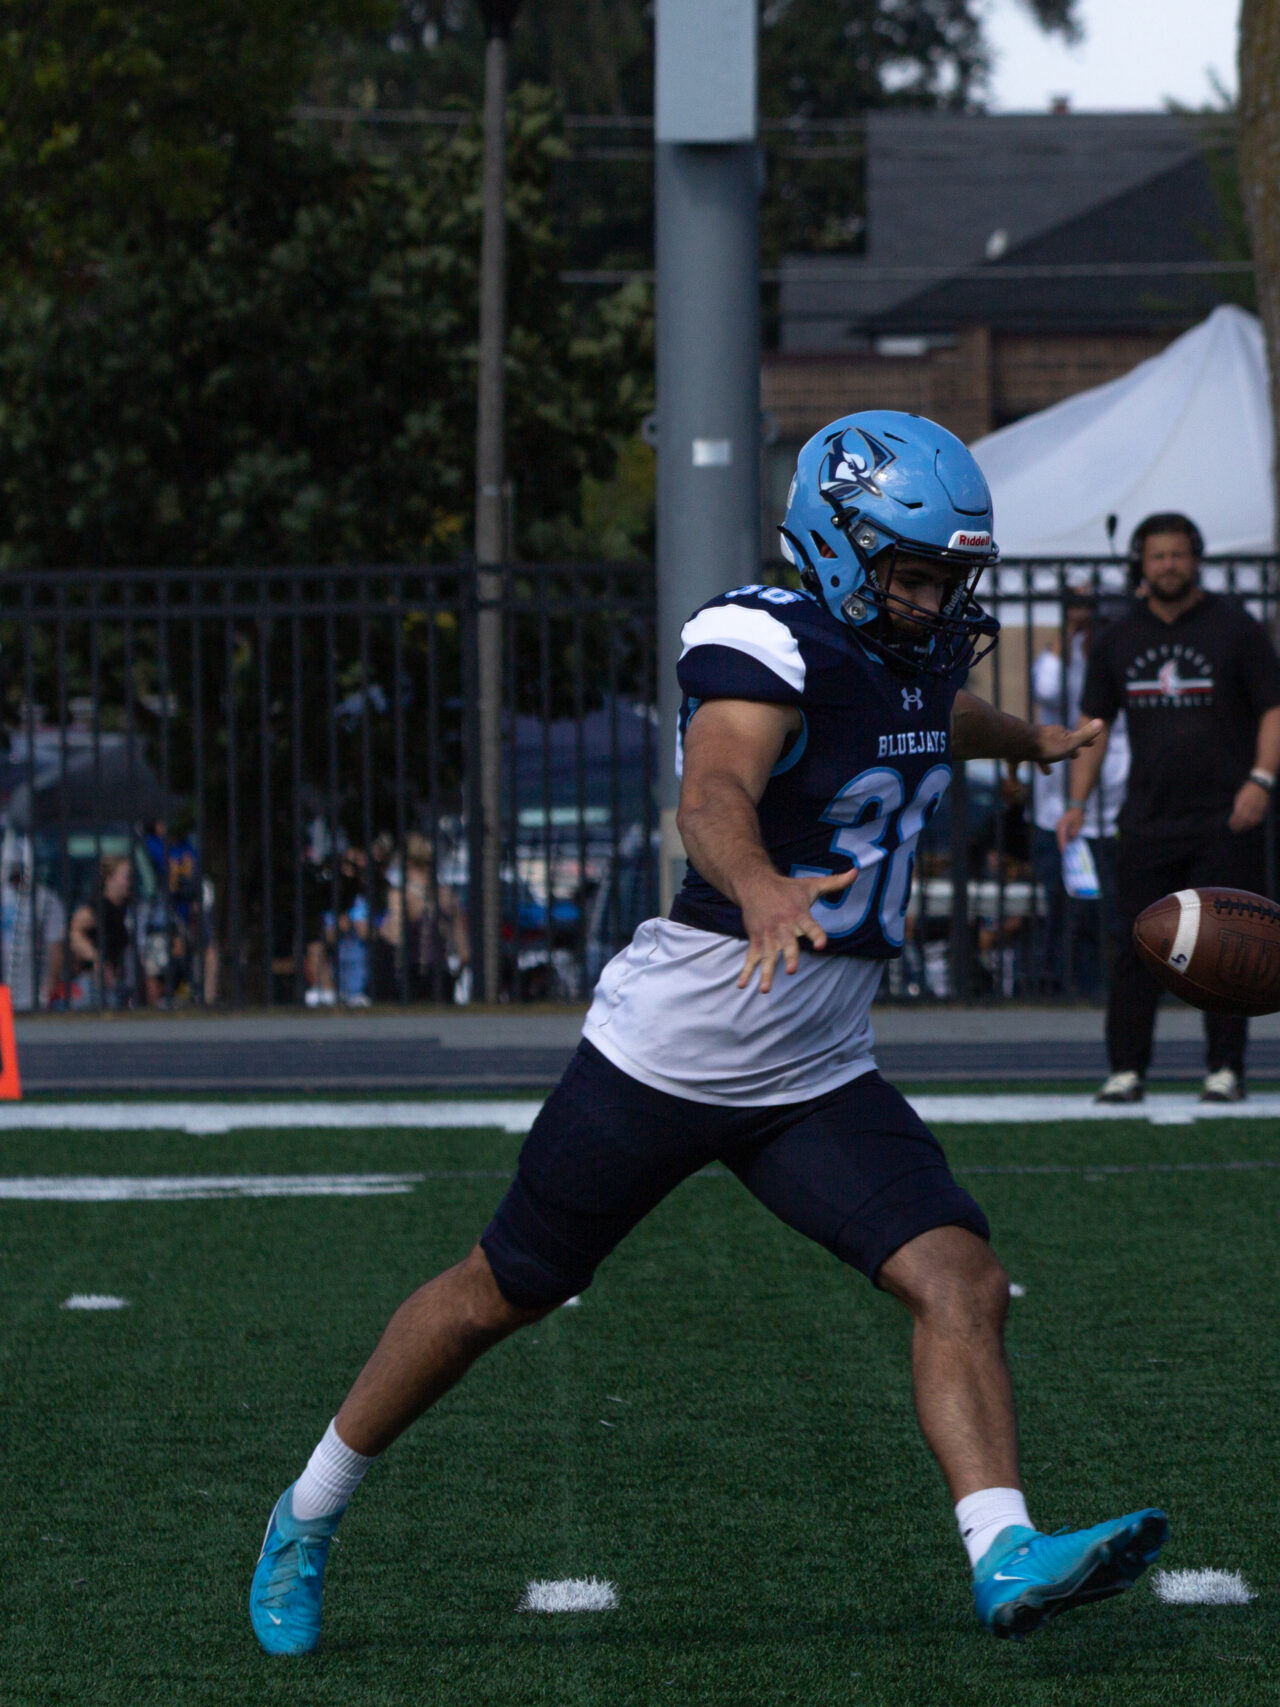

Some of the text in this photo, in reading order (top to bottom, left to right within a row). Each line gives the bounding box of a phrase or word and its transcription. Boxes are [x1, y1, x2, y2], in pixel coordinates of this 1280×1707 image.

[959, 534, 991, 546] Riddell
[877, 730, 947, 759] BLUEJAYS
[789, 763, 953, 947] 30
